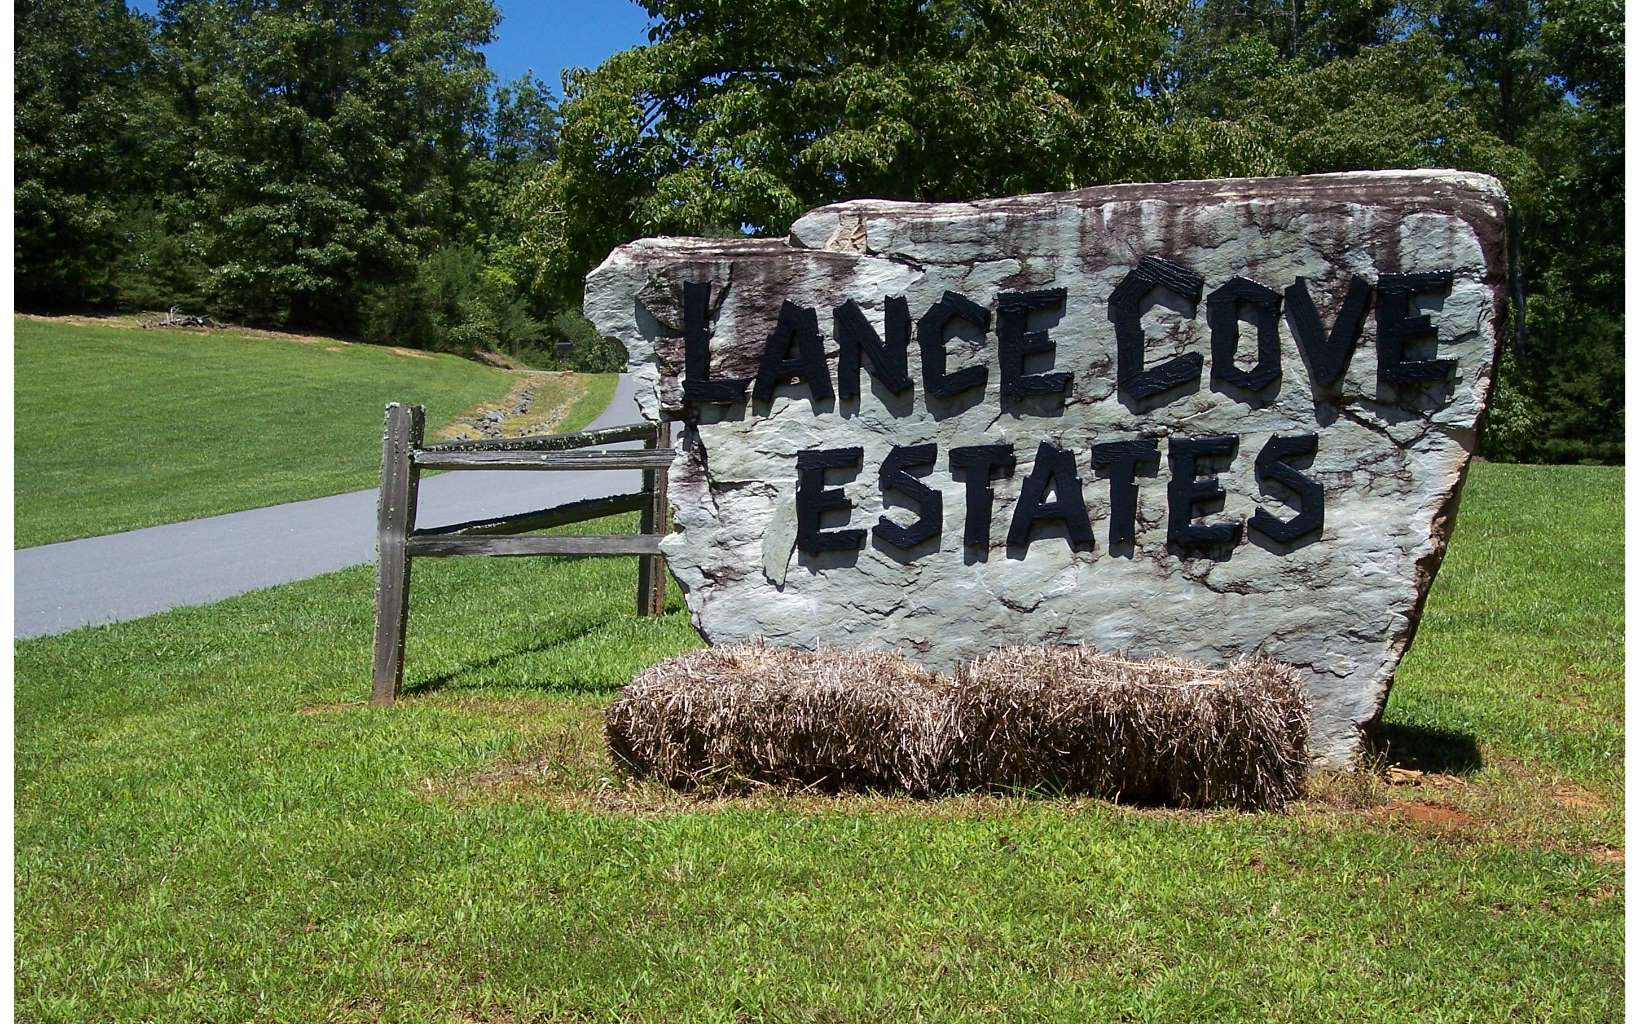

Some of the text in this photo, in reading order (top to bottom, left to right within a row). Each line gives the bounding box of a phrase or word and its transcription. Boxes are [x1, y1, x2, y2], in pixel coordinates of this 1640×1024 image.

[682, 255, 1458, 405] LANCE COVE
[797, 433, 1324, 555] ESTATES
